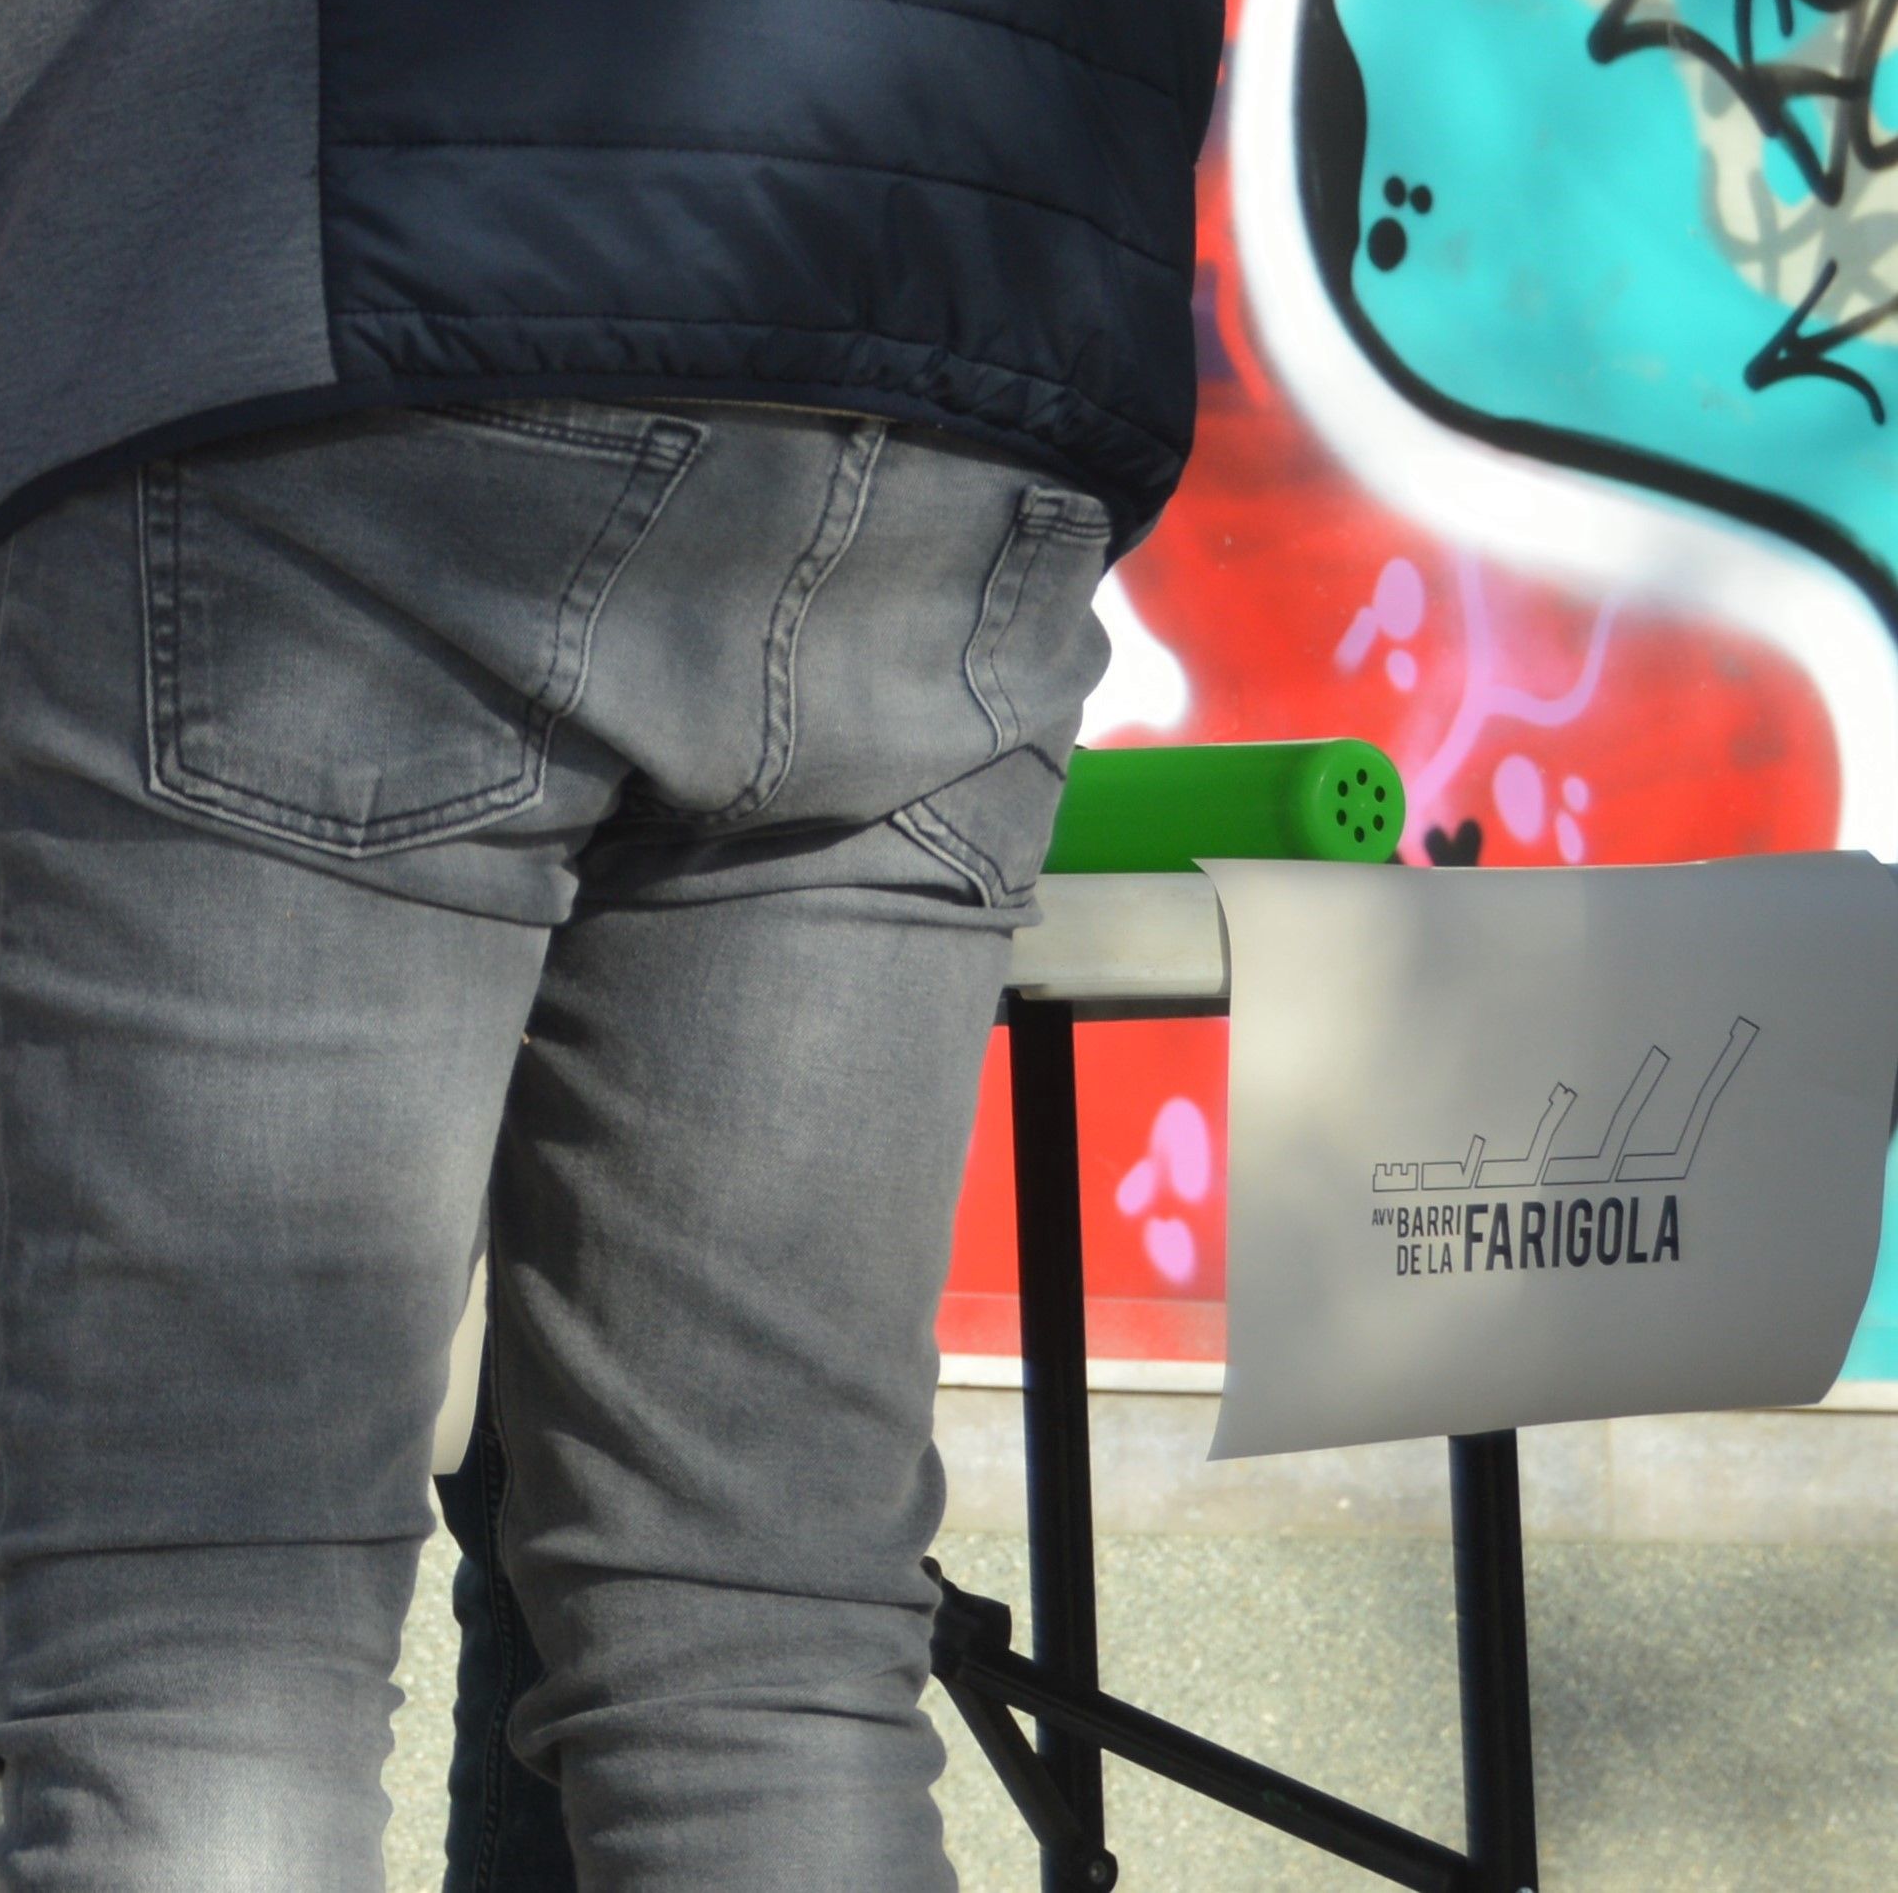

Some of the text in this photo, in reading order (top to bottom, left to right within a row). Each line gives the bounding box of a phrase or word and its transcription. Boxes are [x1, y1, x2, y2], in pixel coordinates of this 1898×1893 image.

[1372, 1205, 1462, 1238] AVV BARRI
[1462, 1195, 1680, 1272] FARIGOLA
[1396, 1243, 1452, 1276] DE LA
